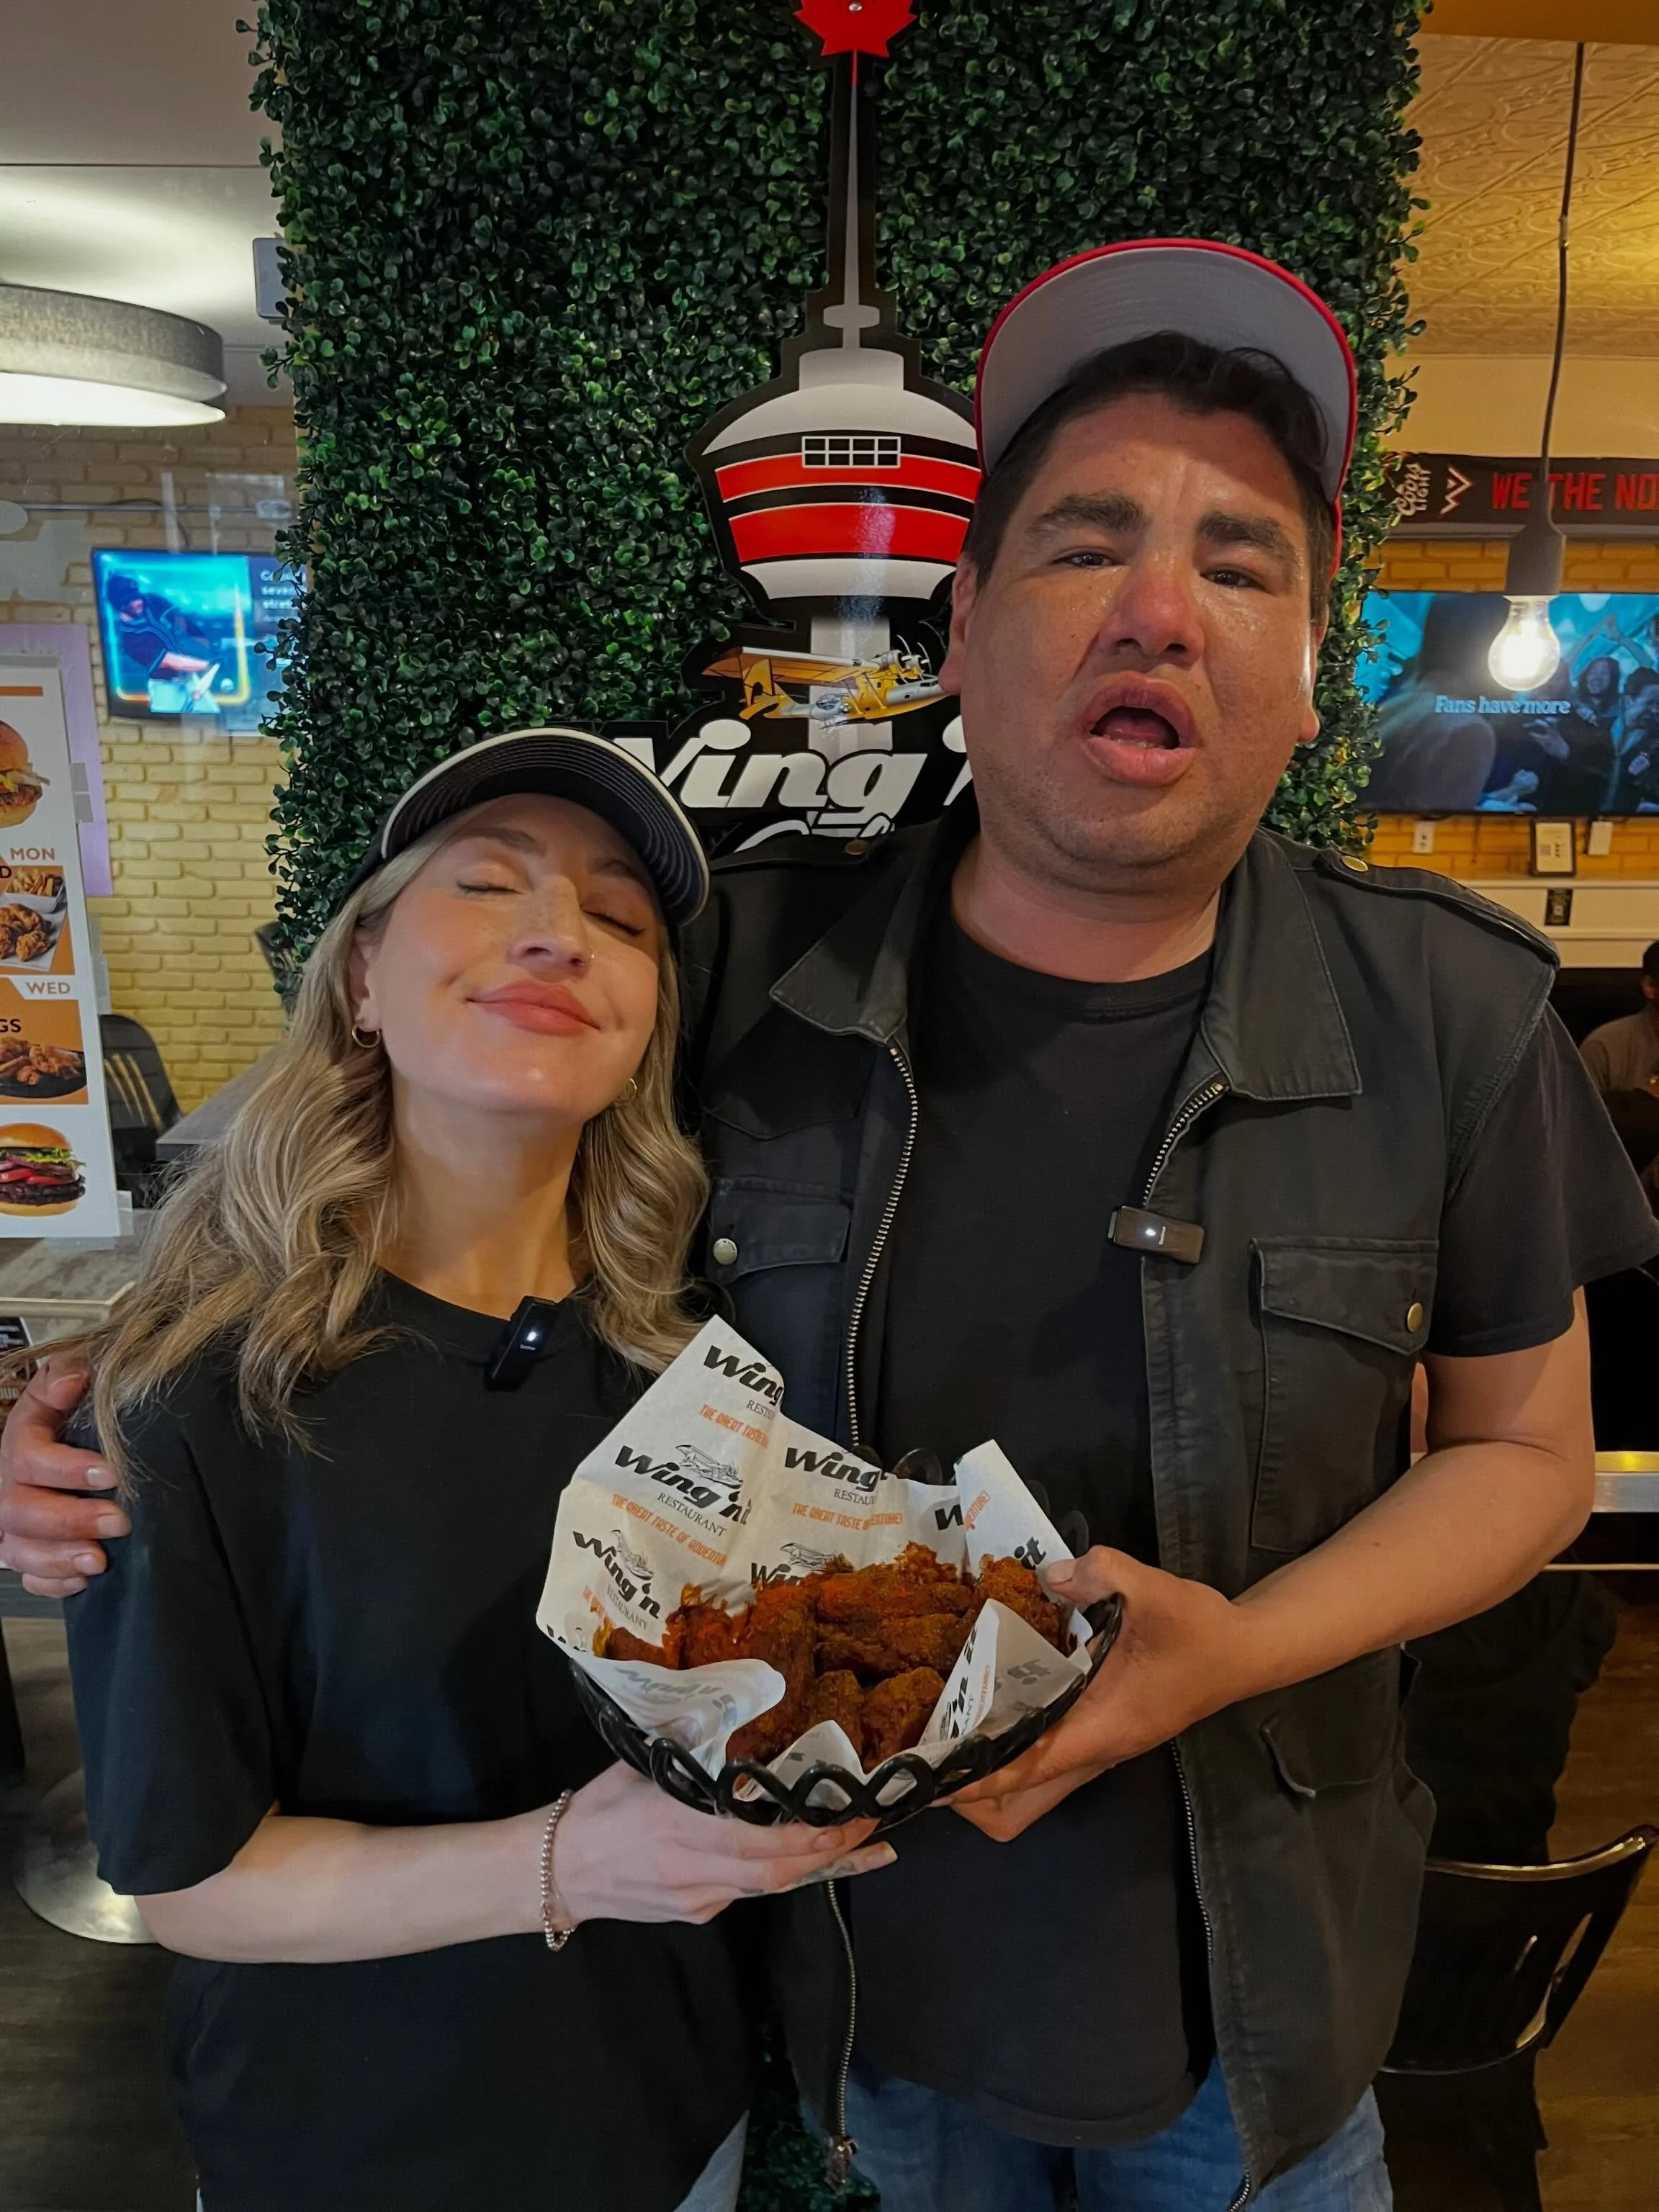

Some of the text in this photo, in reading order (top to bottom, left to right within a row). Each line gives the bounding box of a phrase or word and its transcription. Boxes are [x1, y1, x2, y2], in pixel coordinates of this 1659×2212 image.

[1491, 472, 1532, 510] WE
[1545, 472, 1606, 511] THE
[1435, 695, 1571, 714] Fans have more
[10, 848, 55, 860] MON
[26, 982, 71, 994] WED
[657, 1492, 727, 1537] RESTAURANT
[835, 1514, 863, 1530] TASTE
[651, 1516, 679, 1539] TASTE
